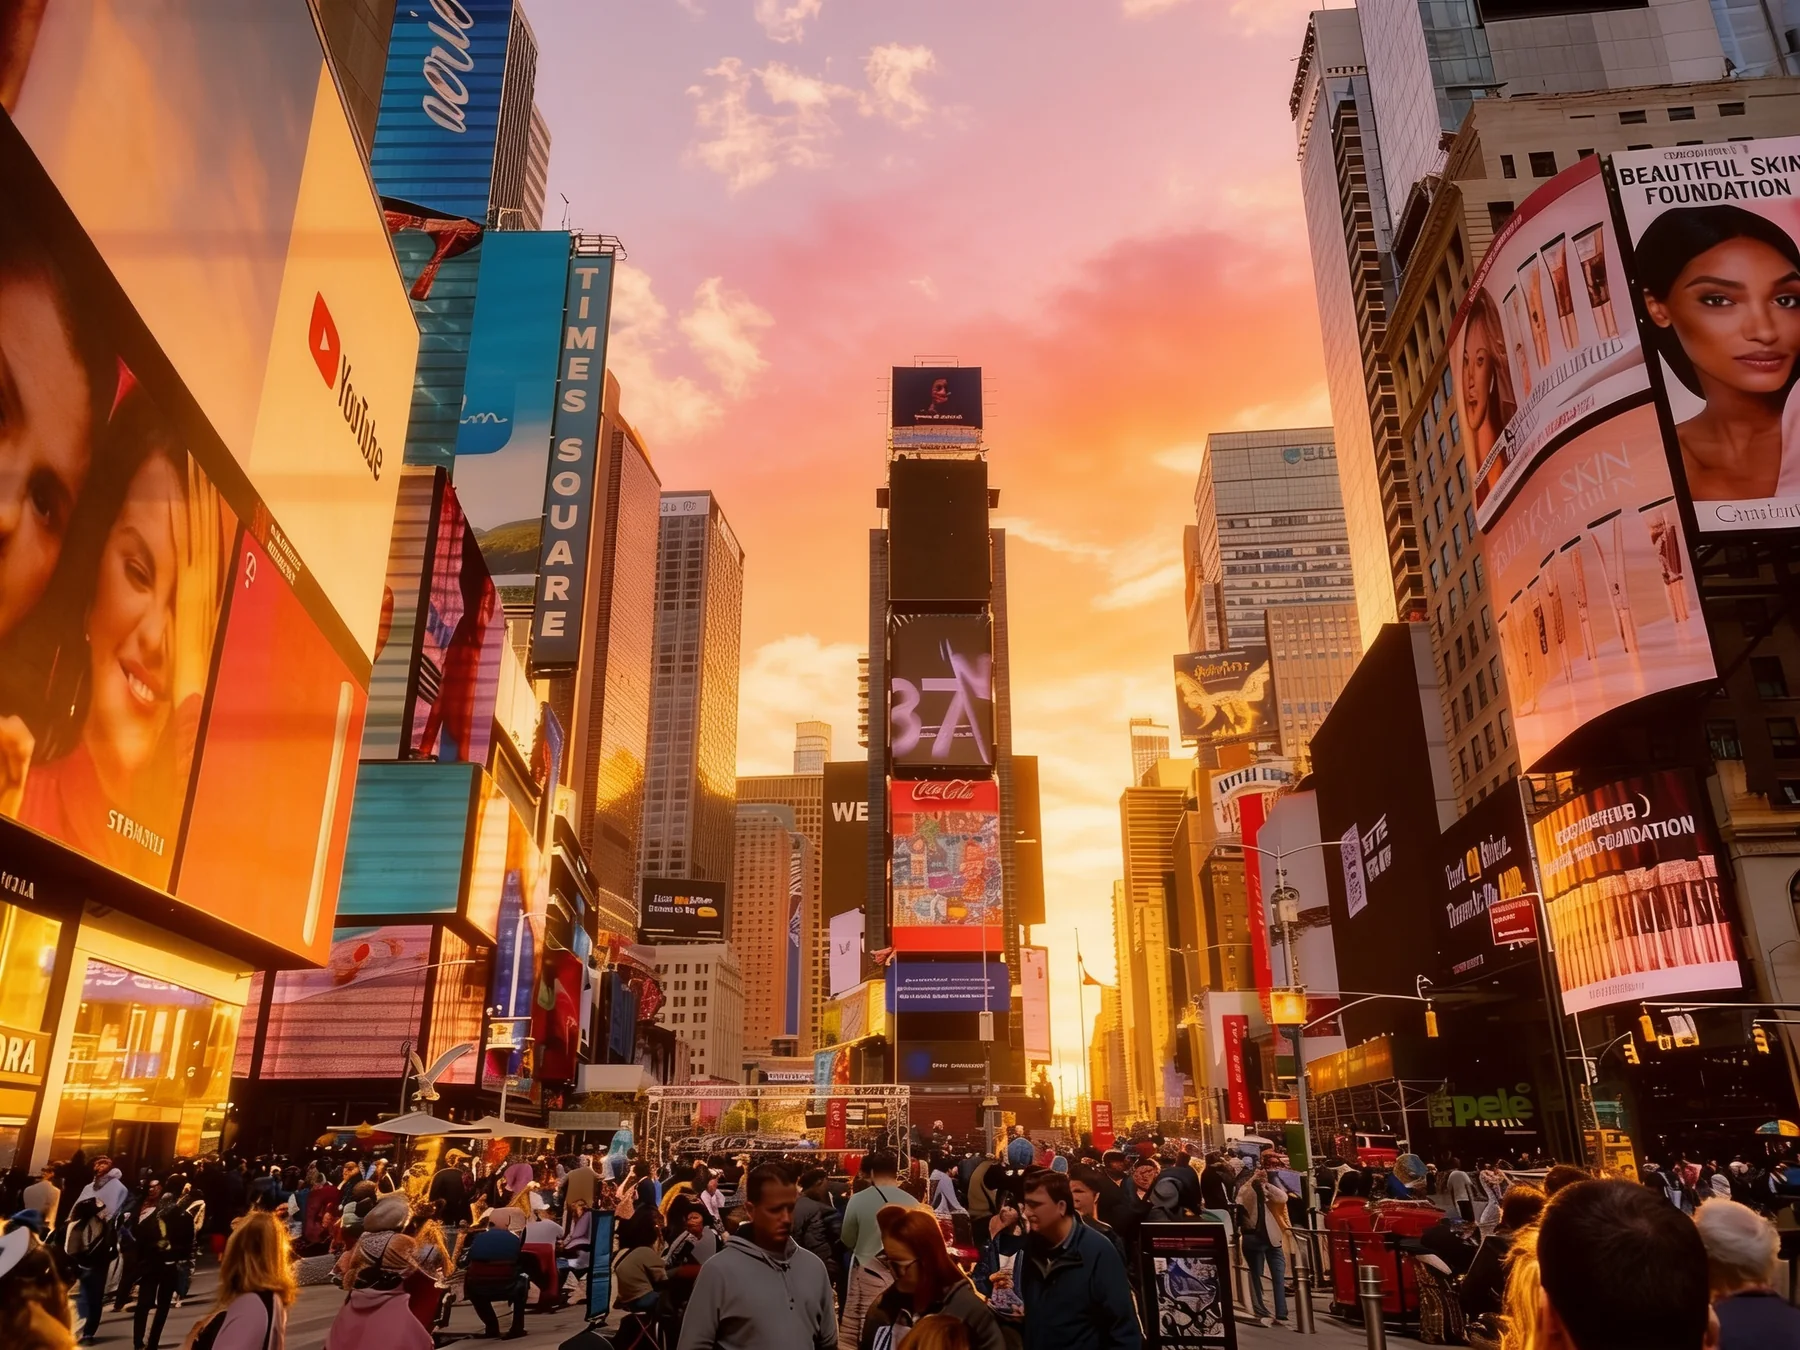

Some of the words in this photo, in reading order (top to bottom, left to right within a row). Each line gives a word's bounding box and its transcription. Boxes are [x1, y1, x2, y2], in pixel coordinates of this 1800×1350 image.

[1620, 159, 1744, 186] BEAUTIFUL
[1645, 178, 1791, 204] FOUNDATION
[562, 268, 599, 412] TIMES
[339, 354, 382, 481] YouTube
[832, 802, 868, 822] WE
